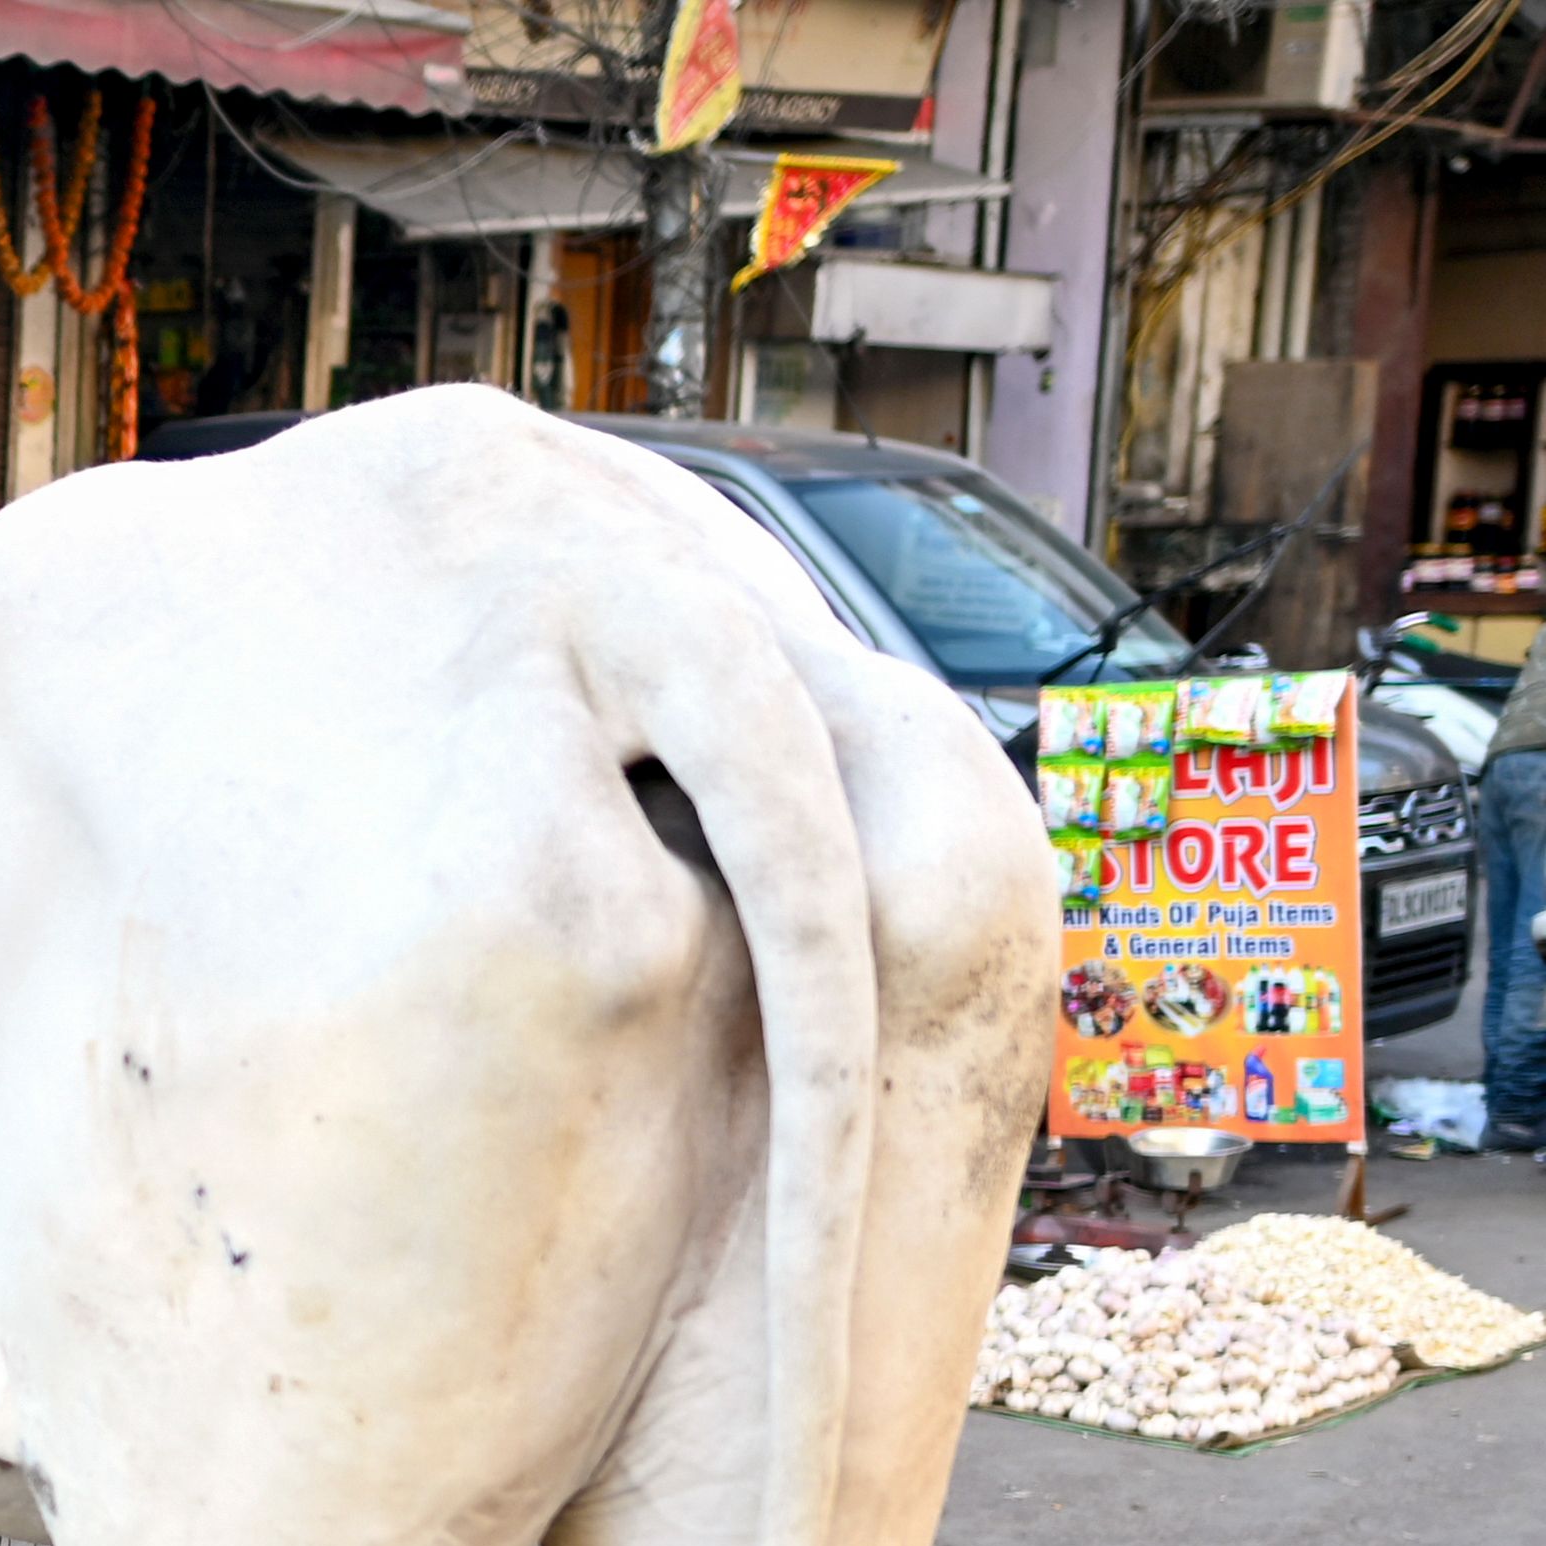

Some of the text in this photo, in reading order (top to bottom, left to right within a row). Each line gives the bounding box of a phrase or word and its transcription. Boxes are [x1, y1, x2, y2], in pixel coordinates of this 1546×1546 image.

[1099, 903, 1160, 925] Kinds
[1169, 904, 1198, 925] OF
[1207, 903, 1259, 929] Puja
[1268, 903, 1335, 923] Items
[1103, 933, 1291, 957] & General Items
